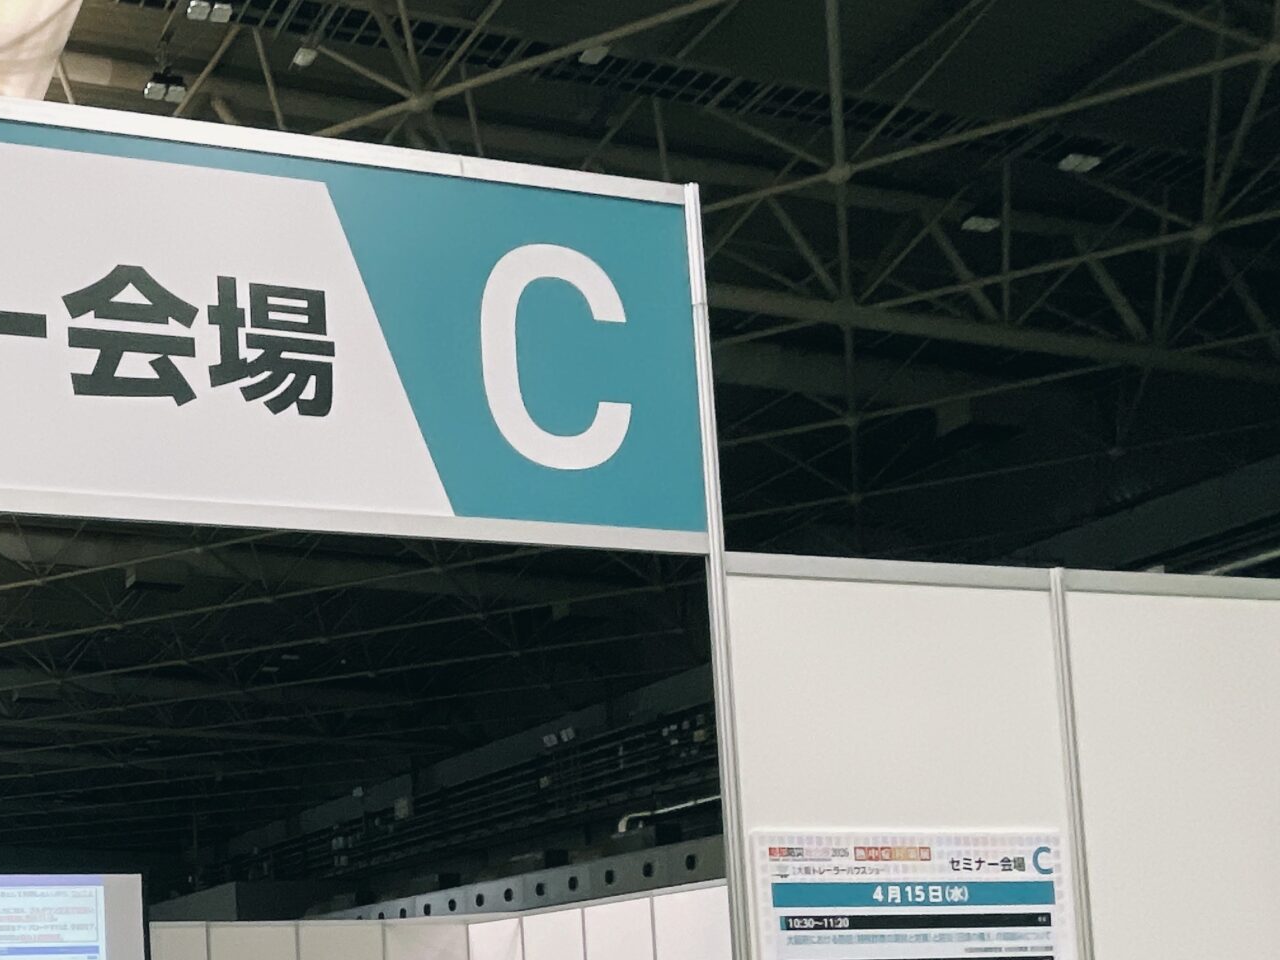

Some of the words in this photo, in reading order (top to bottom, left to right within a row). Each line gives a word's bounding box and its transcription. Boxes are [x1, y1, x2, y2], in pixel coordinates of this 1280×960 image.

[481, 243, 633, 470] C
[949, 857, 1026, 872] セミナー会場
[1032, 846, 1054, 875] C
